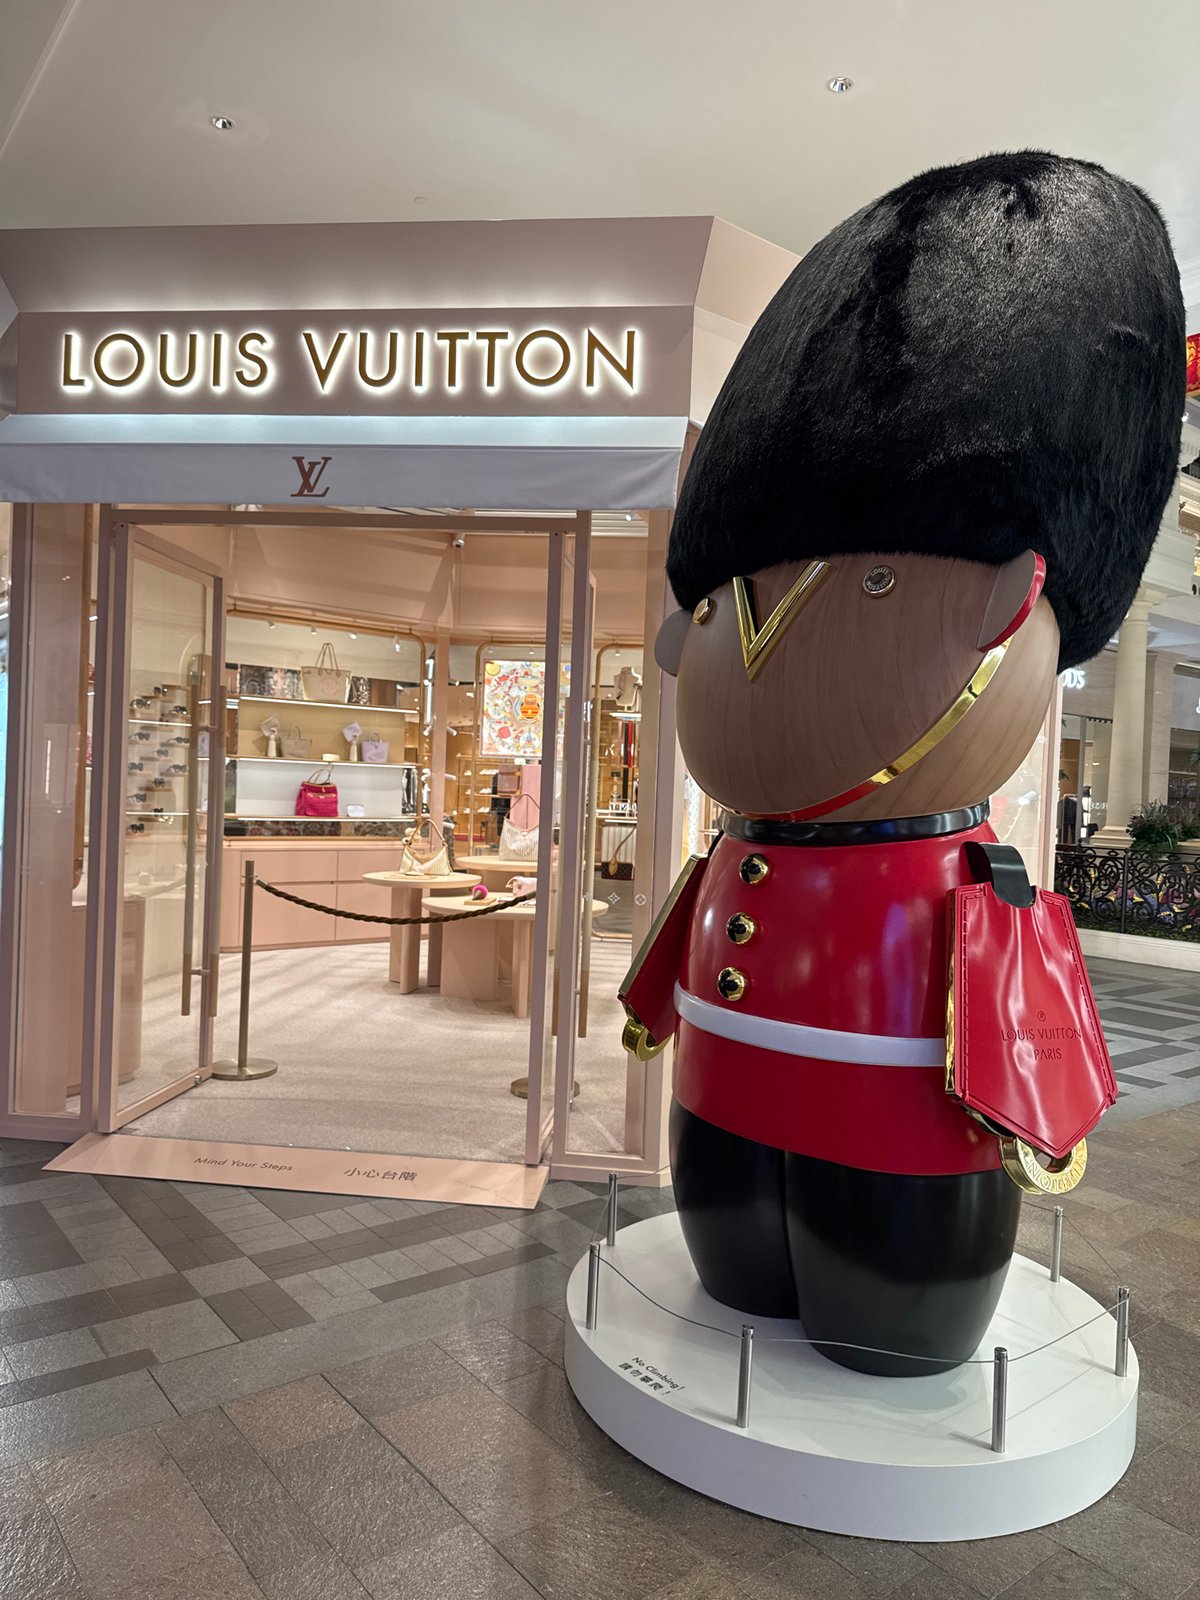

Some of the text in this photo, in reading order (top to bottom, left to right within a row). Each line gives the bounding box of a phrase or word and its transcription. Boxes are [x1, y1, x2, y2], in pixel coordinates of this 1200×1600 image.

[62, 328, 637, 390] LOUIS VUITTON
[1001, 1027, 1081, 1041] LOUIS VUITTON
[1034, 1047, 1062, 1061] PARIS
[194, 1157, 293, 1172] Mind Your Steps
[344, 1167, 418, 1182] 小心台階
[632, 1357, 645, 1367] No
